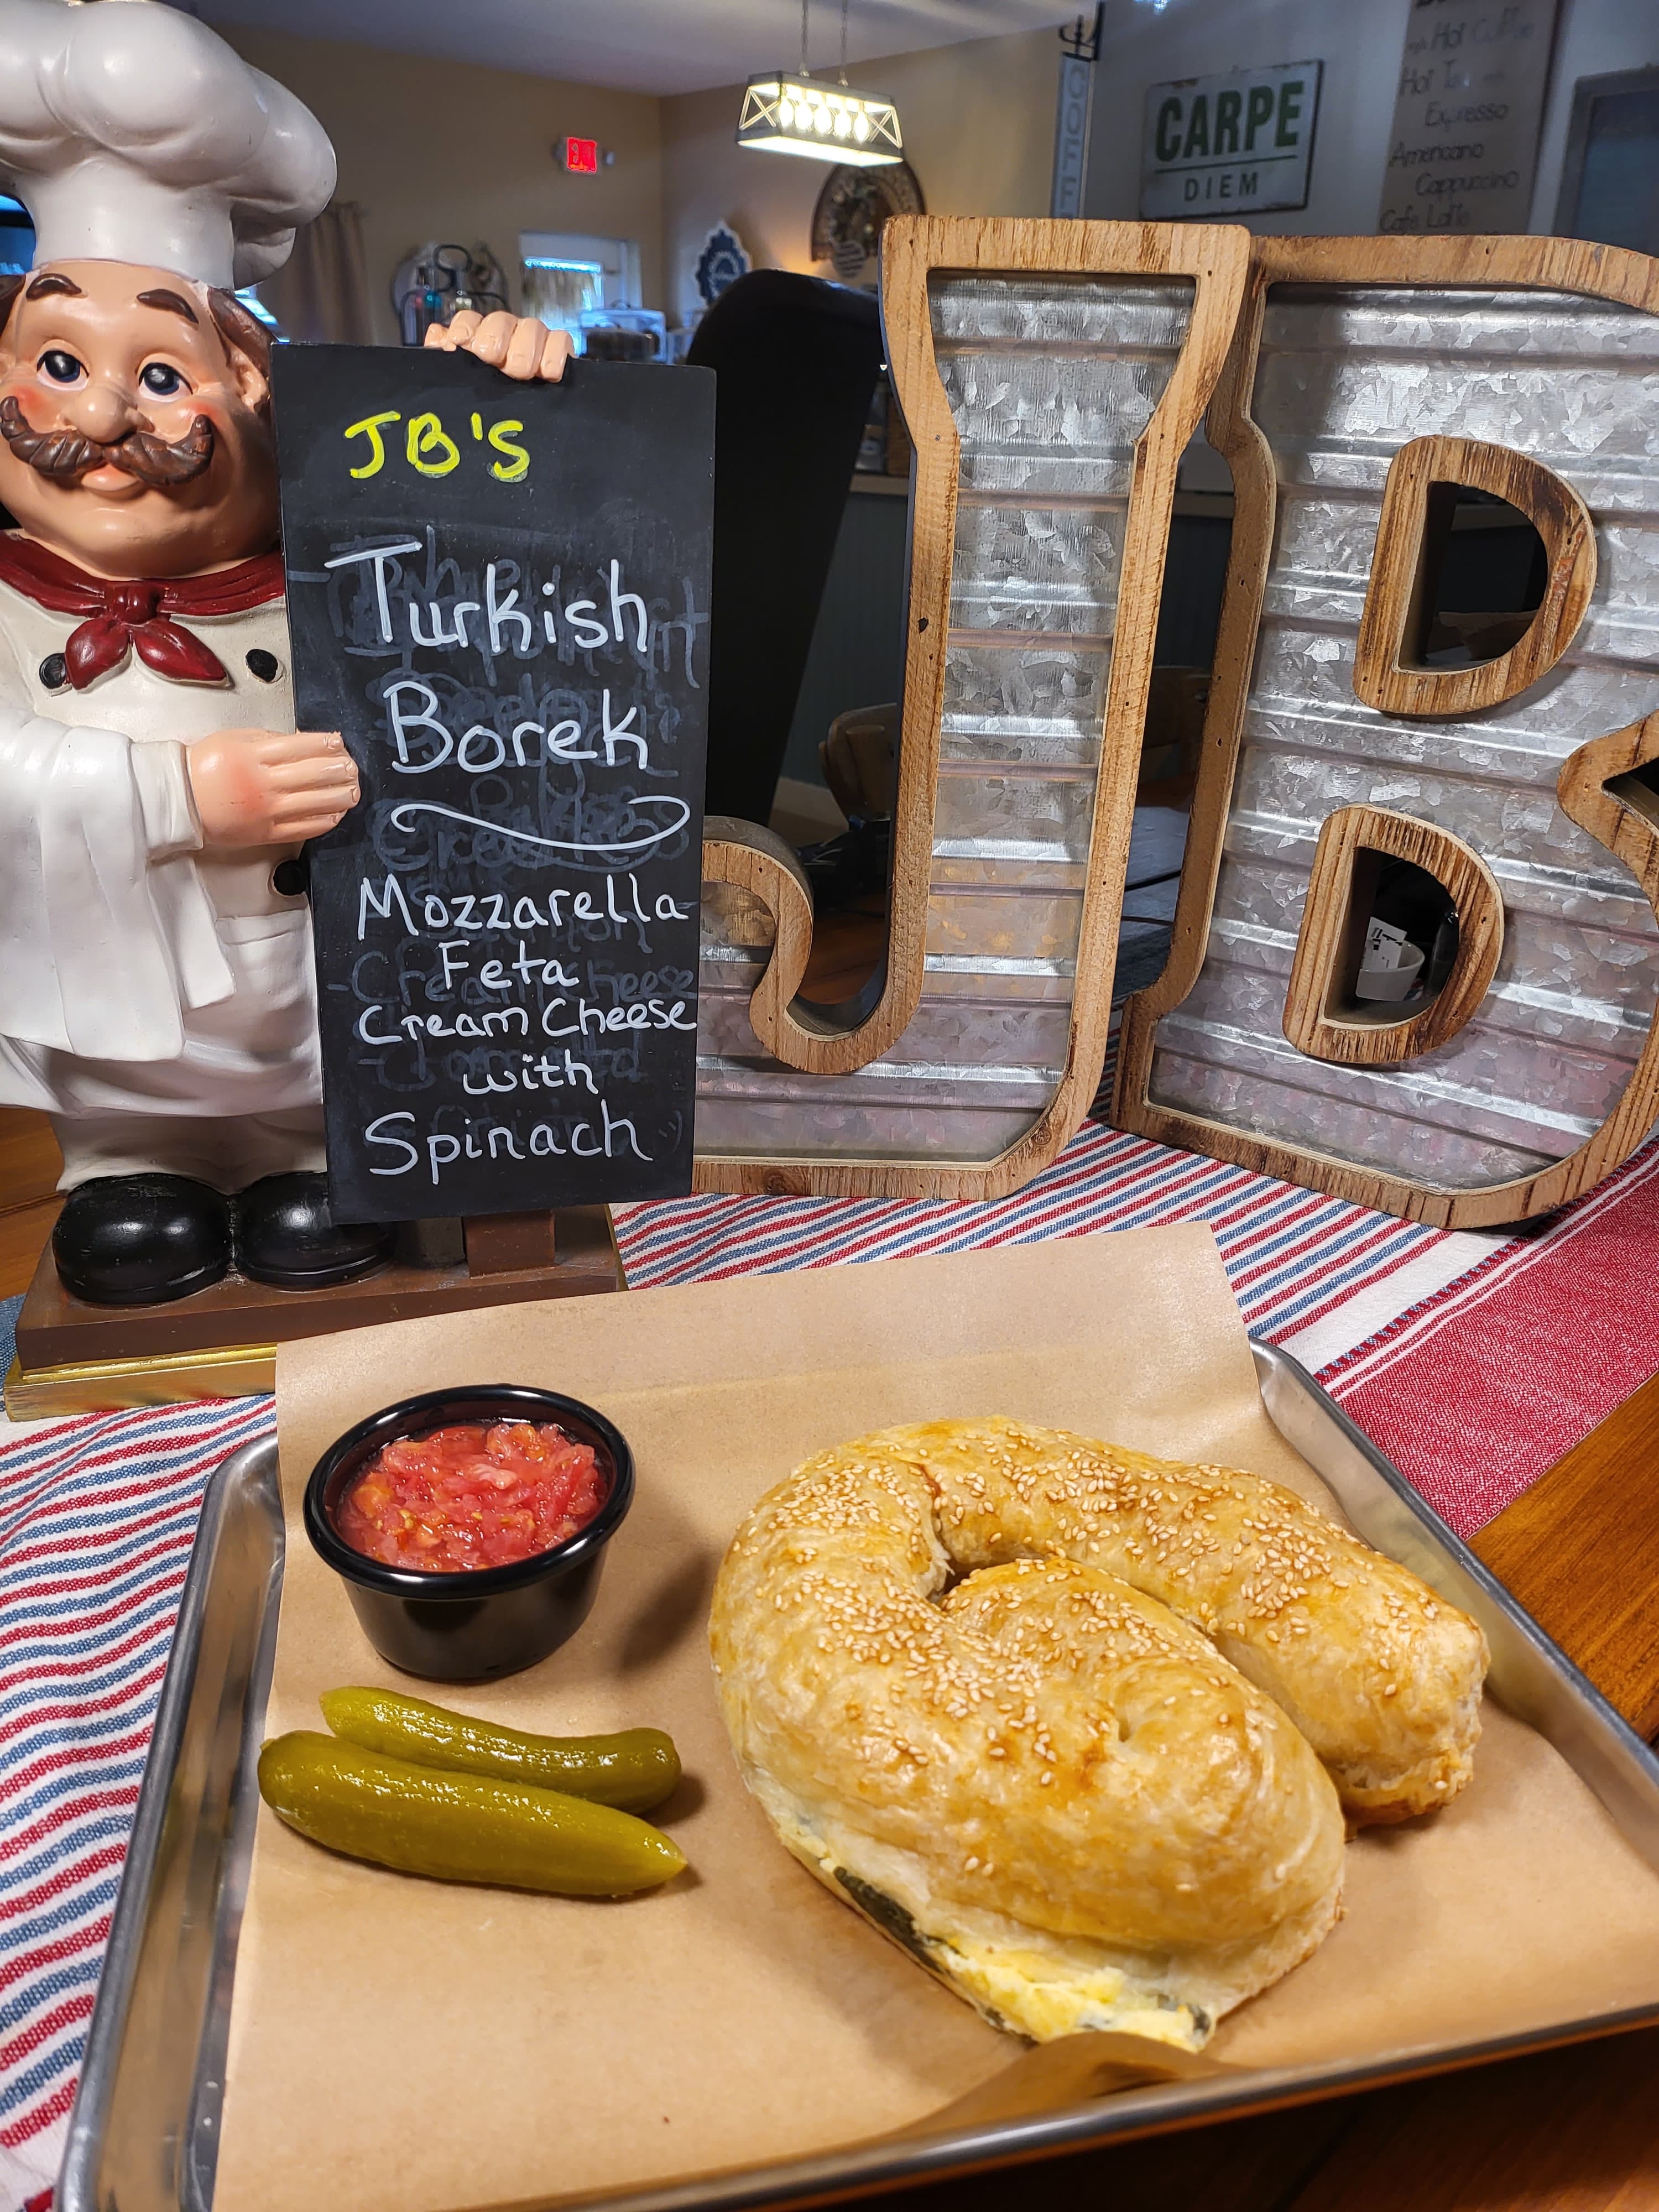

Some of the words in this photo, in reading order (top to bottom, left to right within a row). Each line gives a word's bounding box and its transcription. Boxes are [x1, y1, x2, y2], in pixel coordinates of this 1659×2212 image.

[1154, 80, 1305, 162] CARPE
[1183, 172, 1259, 202] DIEM
[324, 540, 648, 653] Turkish
[383, 680, 650, 774] Borek
[357, 873, 689, 940] Mozzarella
[439, 940, 580, 990] Feta
[358, 1005, 529, 1045] Cream
[541, 998, 697, 1036] Cheese
[462, 1048, 599, 1095] with
[364, 1098, 654, 1185] Spinach
